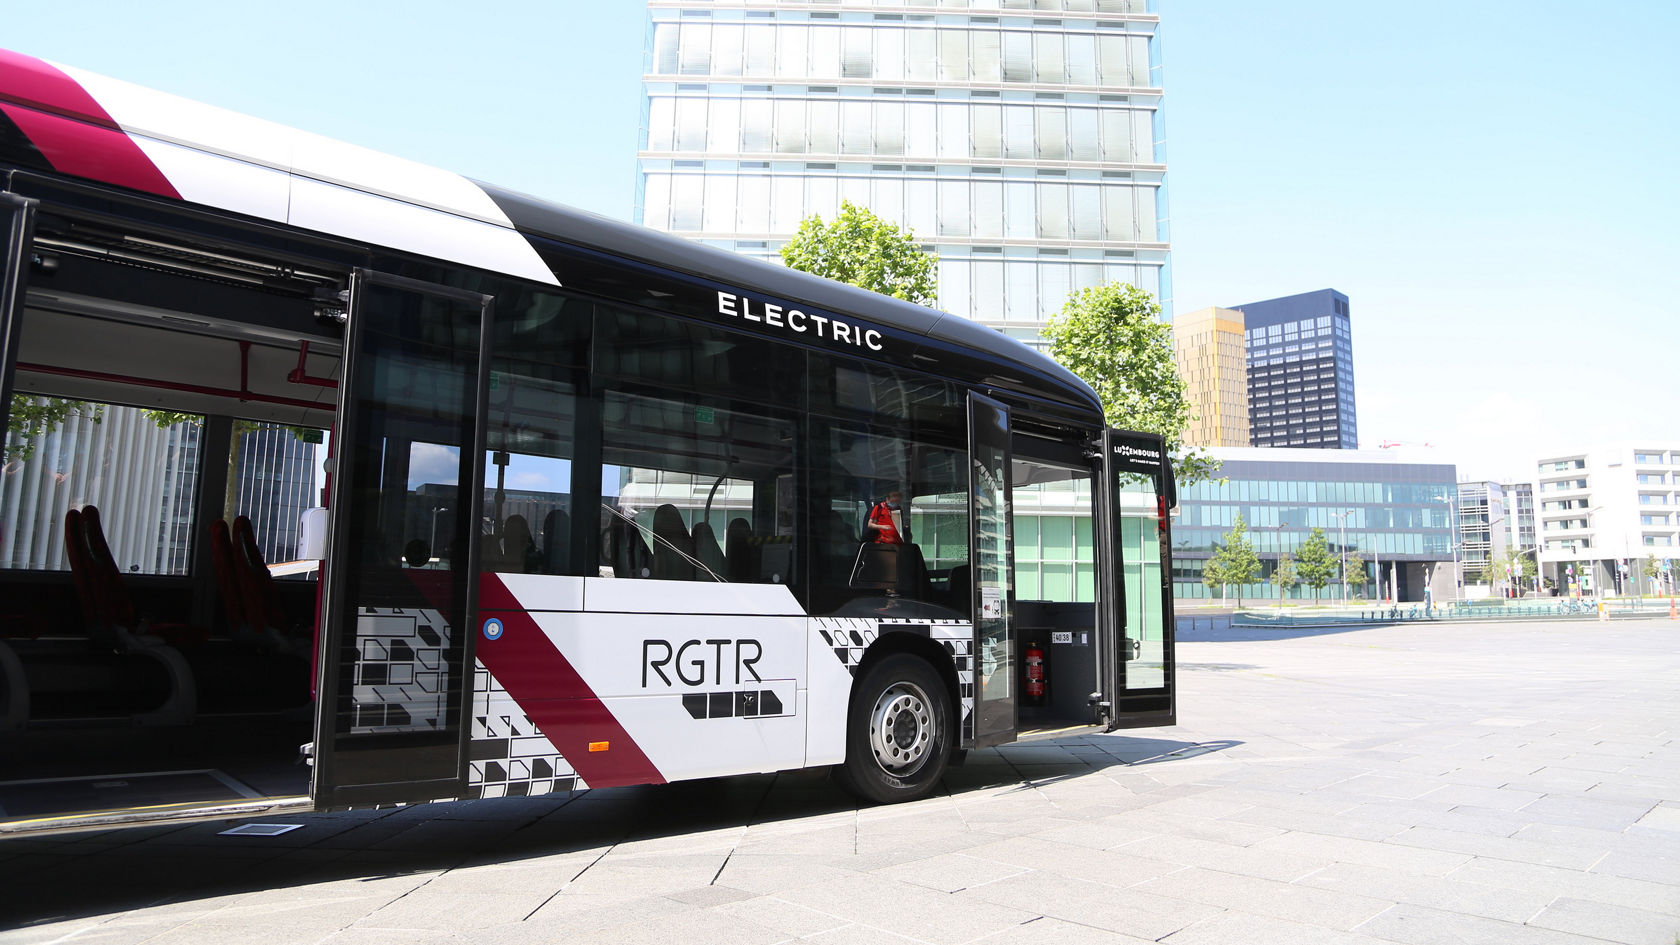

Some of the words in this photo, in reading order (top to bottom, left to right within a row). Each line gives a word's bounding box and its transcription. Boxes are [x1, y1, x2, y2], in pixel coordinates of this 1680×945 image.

[718, 291, 883, 351] ELECTRIC
[1114, 445, 1160, 458] LUXEMBOURG
[642, 639, 762, 688] RGTR
